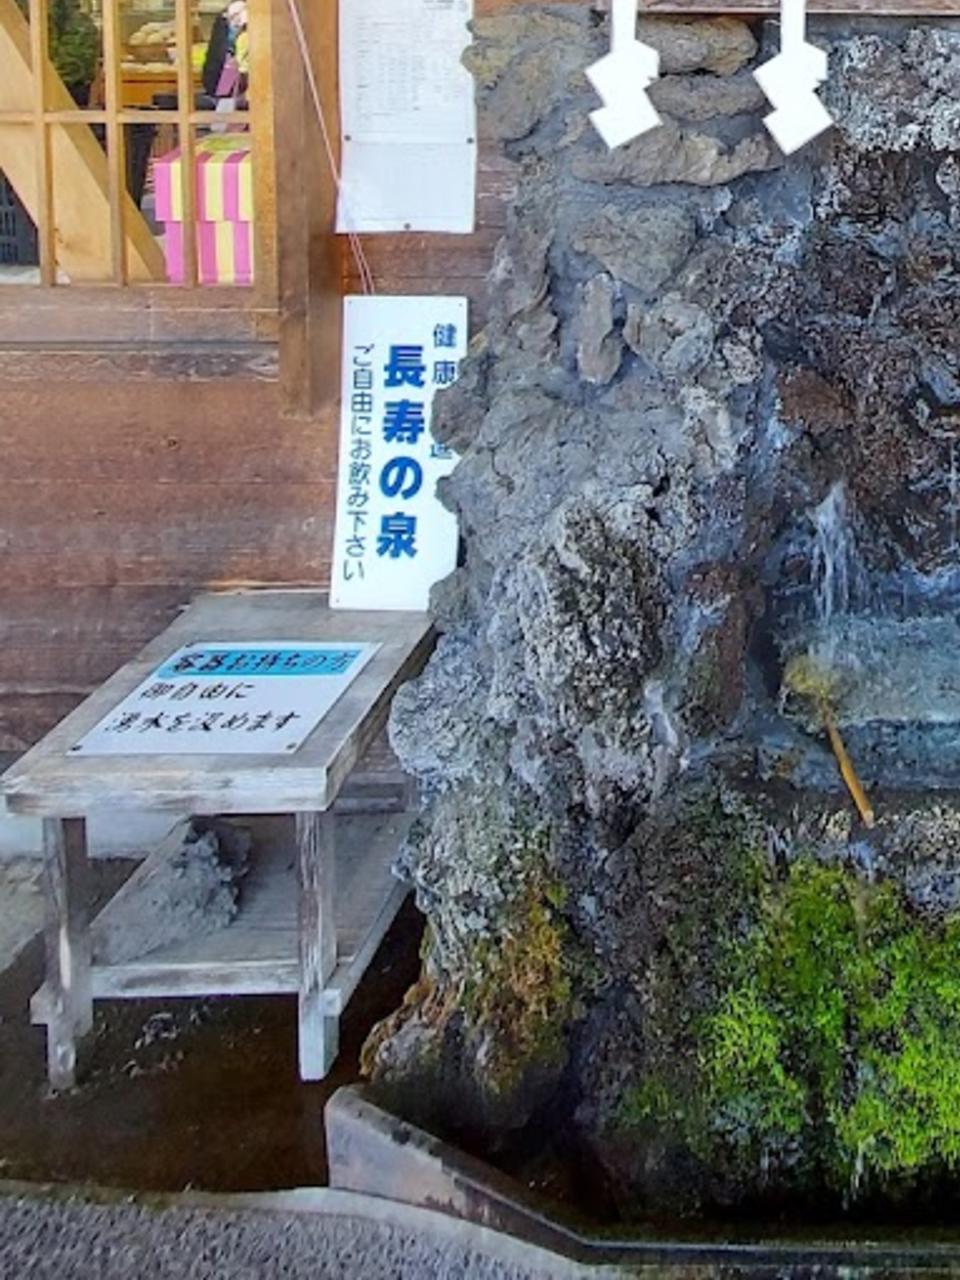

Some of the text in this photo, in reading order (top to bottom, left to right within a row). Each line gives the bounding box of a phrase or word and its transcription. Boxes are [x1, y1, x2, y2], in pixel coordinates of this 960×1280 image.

[342, 343, 376, 581] ご自由にお飲み下さい
[376, 343, 427, 560] 長寿の泉
